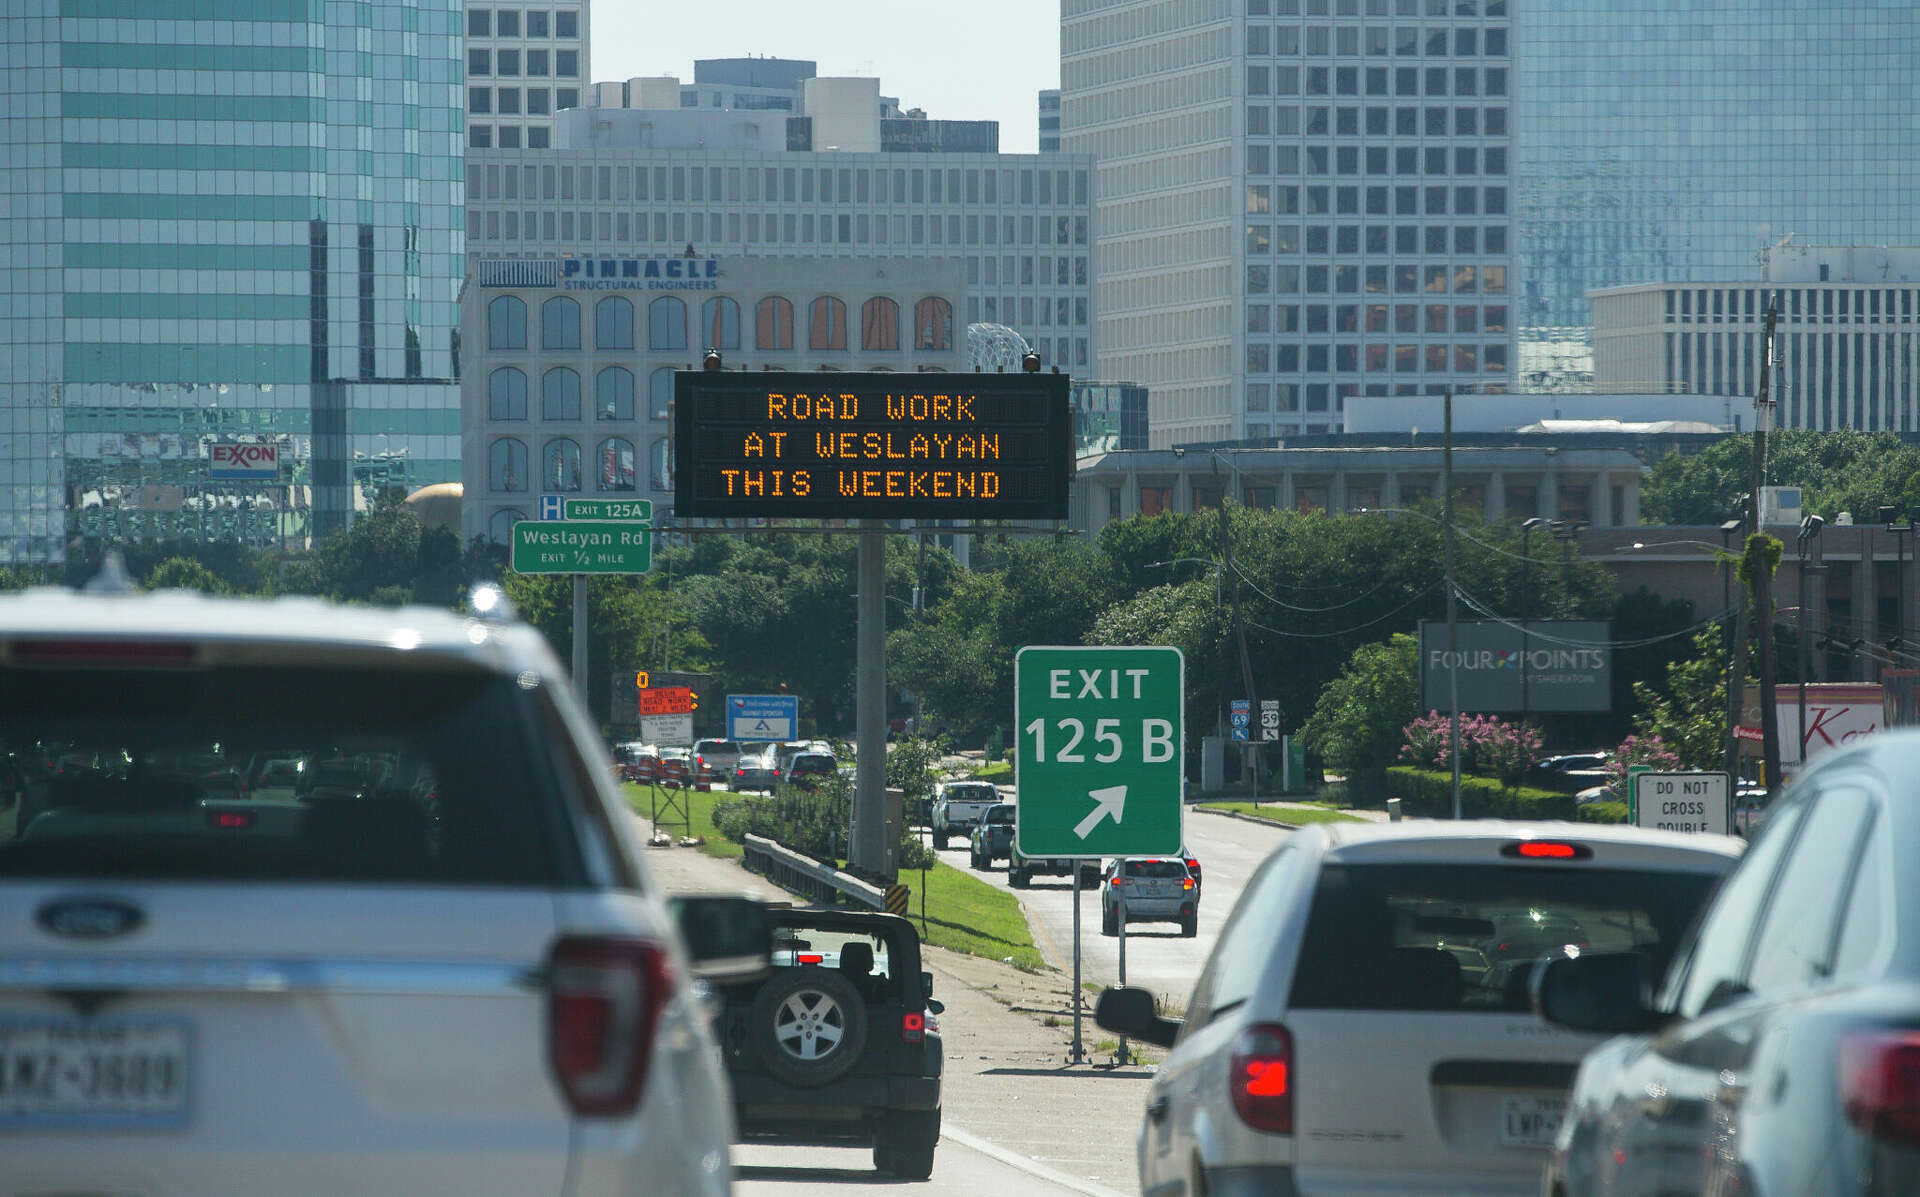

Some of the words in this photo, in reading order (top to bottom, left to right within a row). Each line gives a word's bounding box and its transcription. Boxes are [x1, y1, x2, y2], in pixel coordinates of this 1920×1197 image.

[564, 259, 717, 278] PINNACLE
[564, 280, 642, 290] STRUCTURAL
[647, 280, 717, 290] ENGINEERS
[768, 393, 858, 421] ROAD
[886, 393, 976, 421] WORK
[744, 432, 788, 458] AT
[815, 432, 1000, 459] WESLAYAN
[213, 444, 275, 468] EXXON
[721, 469, 811, 497] THIS
[838, 470, 1000, 498] WEEKEND
[575, 505, 598, 515] EXIT
[605, 503, 643, 517] 125A
[523, 530, 612, 548] Weslayan
[620, 530, 643, 545] Rd
[541, 553, 565, 562] EXIT
[598, 553, 624, 563] MILE
[1430, 650, 1496, 670] FOUR
[1519, 650, 1605, 670] POINTS
[1050, 669, 1149, 699] EXIT
[1233, 715, 1248, 725] 69
[1263, 713, 1278, 724] 59
[1025, 718, 1123, 763] 125
[1142, 718, 1175, 763] B
[1656, 781, 1674, 795] DO
[1682, 781, 1709, 795] NOT
[1662, 802, 1704, 815] CROSS
